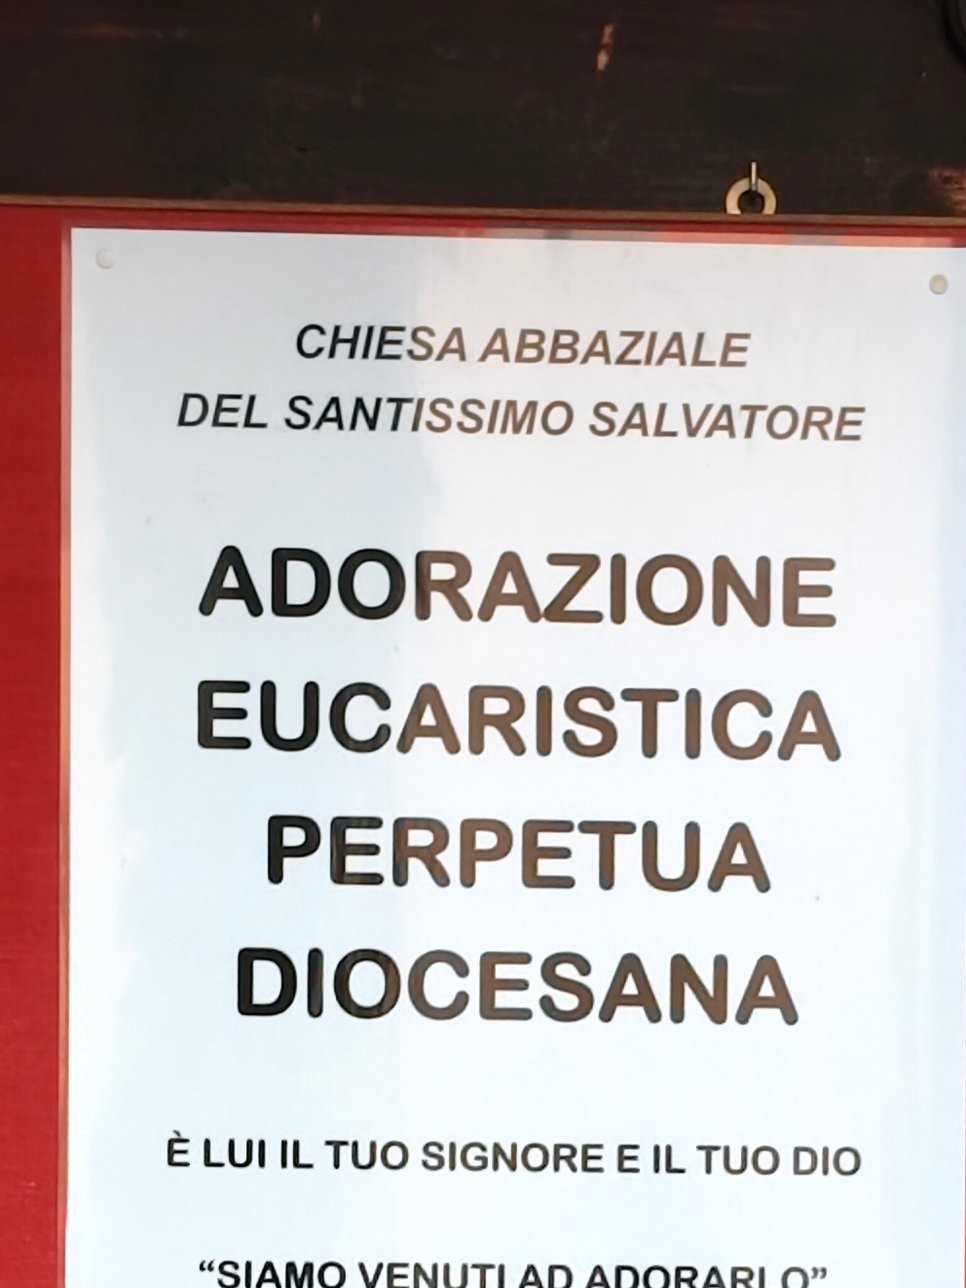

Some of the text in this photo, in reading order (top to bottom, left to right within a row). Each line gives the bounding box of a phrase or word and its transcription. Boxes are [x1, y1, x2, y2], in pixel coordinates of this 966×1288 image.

[295, 323, 751, 367] CHIESA ABBAZIALE
[177, 392, 866, 441] DEL SANTISSIMO SALVATORE
[198, 544, 837, 628] ADORAZIONE
[197, 679, 841, 762] EUCARISTICA
[267, 814, 771, 894] PERPETUA
[236, 946, 799, 1026] DIOCESANA
[166, 1129, 861, 1176] È LUI IL TUO SIGNORE E IL TUO DIO
